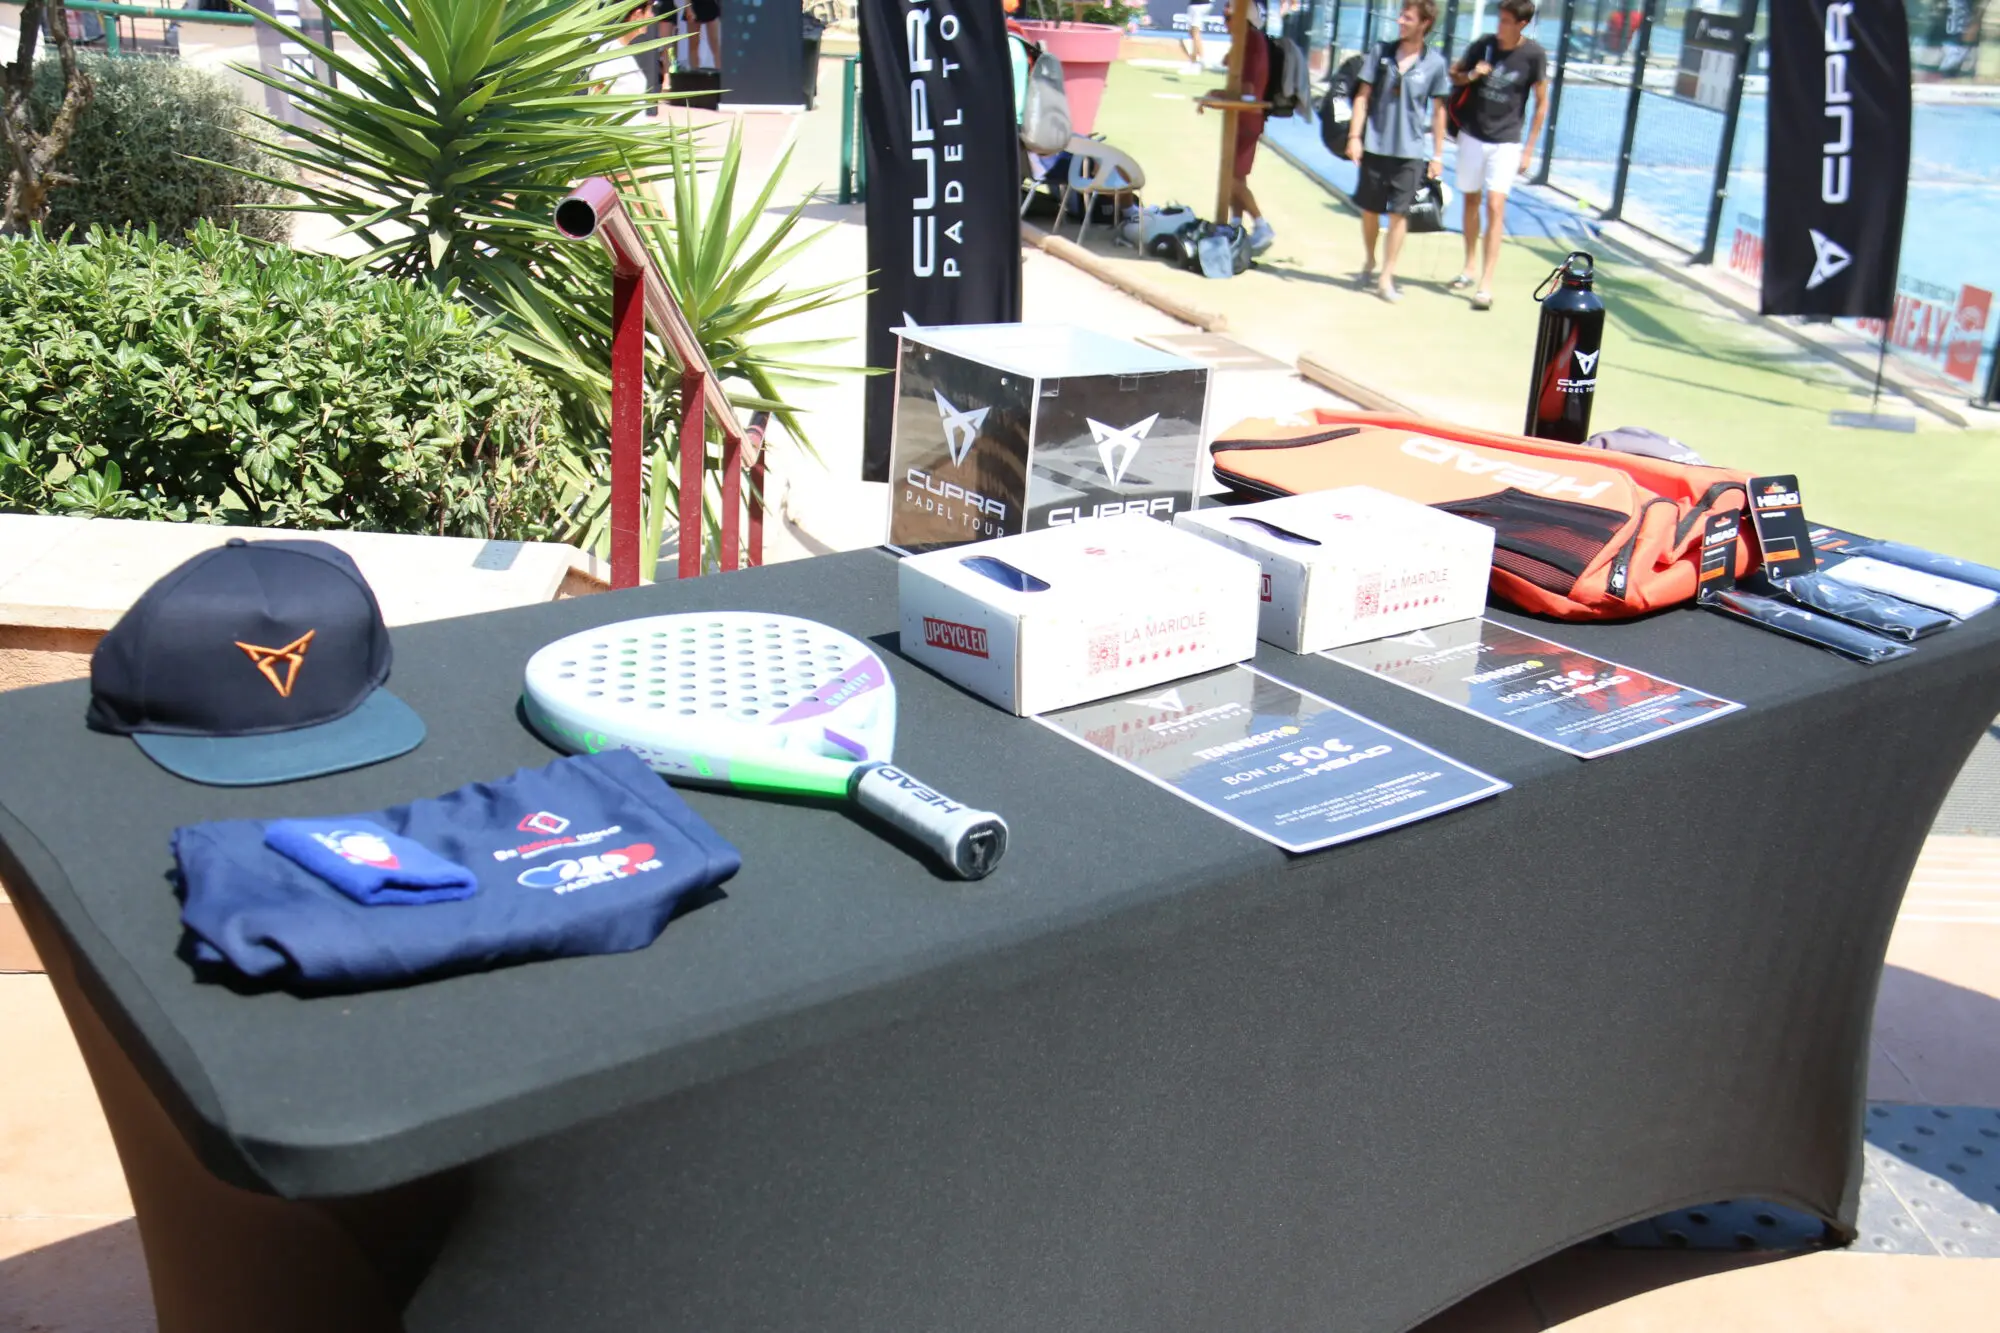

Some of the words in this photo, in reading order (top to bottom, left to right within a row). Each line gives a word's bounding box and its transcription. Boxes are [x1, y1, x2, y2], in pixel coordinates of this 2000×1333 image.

[939, 14, 961, 78] TO
[1822, 2, 1854, 204] CUPR
[906, 0, 936, 277] CUPR
[943, 108, 964, 277] PADEL
[1400, 437, 1613, 499] HEAD
[907, 468, 1006, 521] CUPRA
[1757, 492, 1799, 507] HEAD
[906, 490, 953, 519] PADEL
[963, 512, 1004, 538] TOUR
[1048, 497, 1174, 526] CUPRA
[1705, 527, 1738, 546] HEAD
[924, 620, 987, 653] UPCYCLED
[1124, 628, 1141, 643] LA
[1145, 611, 1206, 638] MARIOLE
[1267, 762, 1290, 774] DE
[1277, 738, 1354, 767] 50€
[1304, 744, 1393, 776] HEAD
[877, 767, 961, 814] HEAD
[1221, 768, 1268, 786] BON
